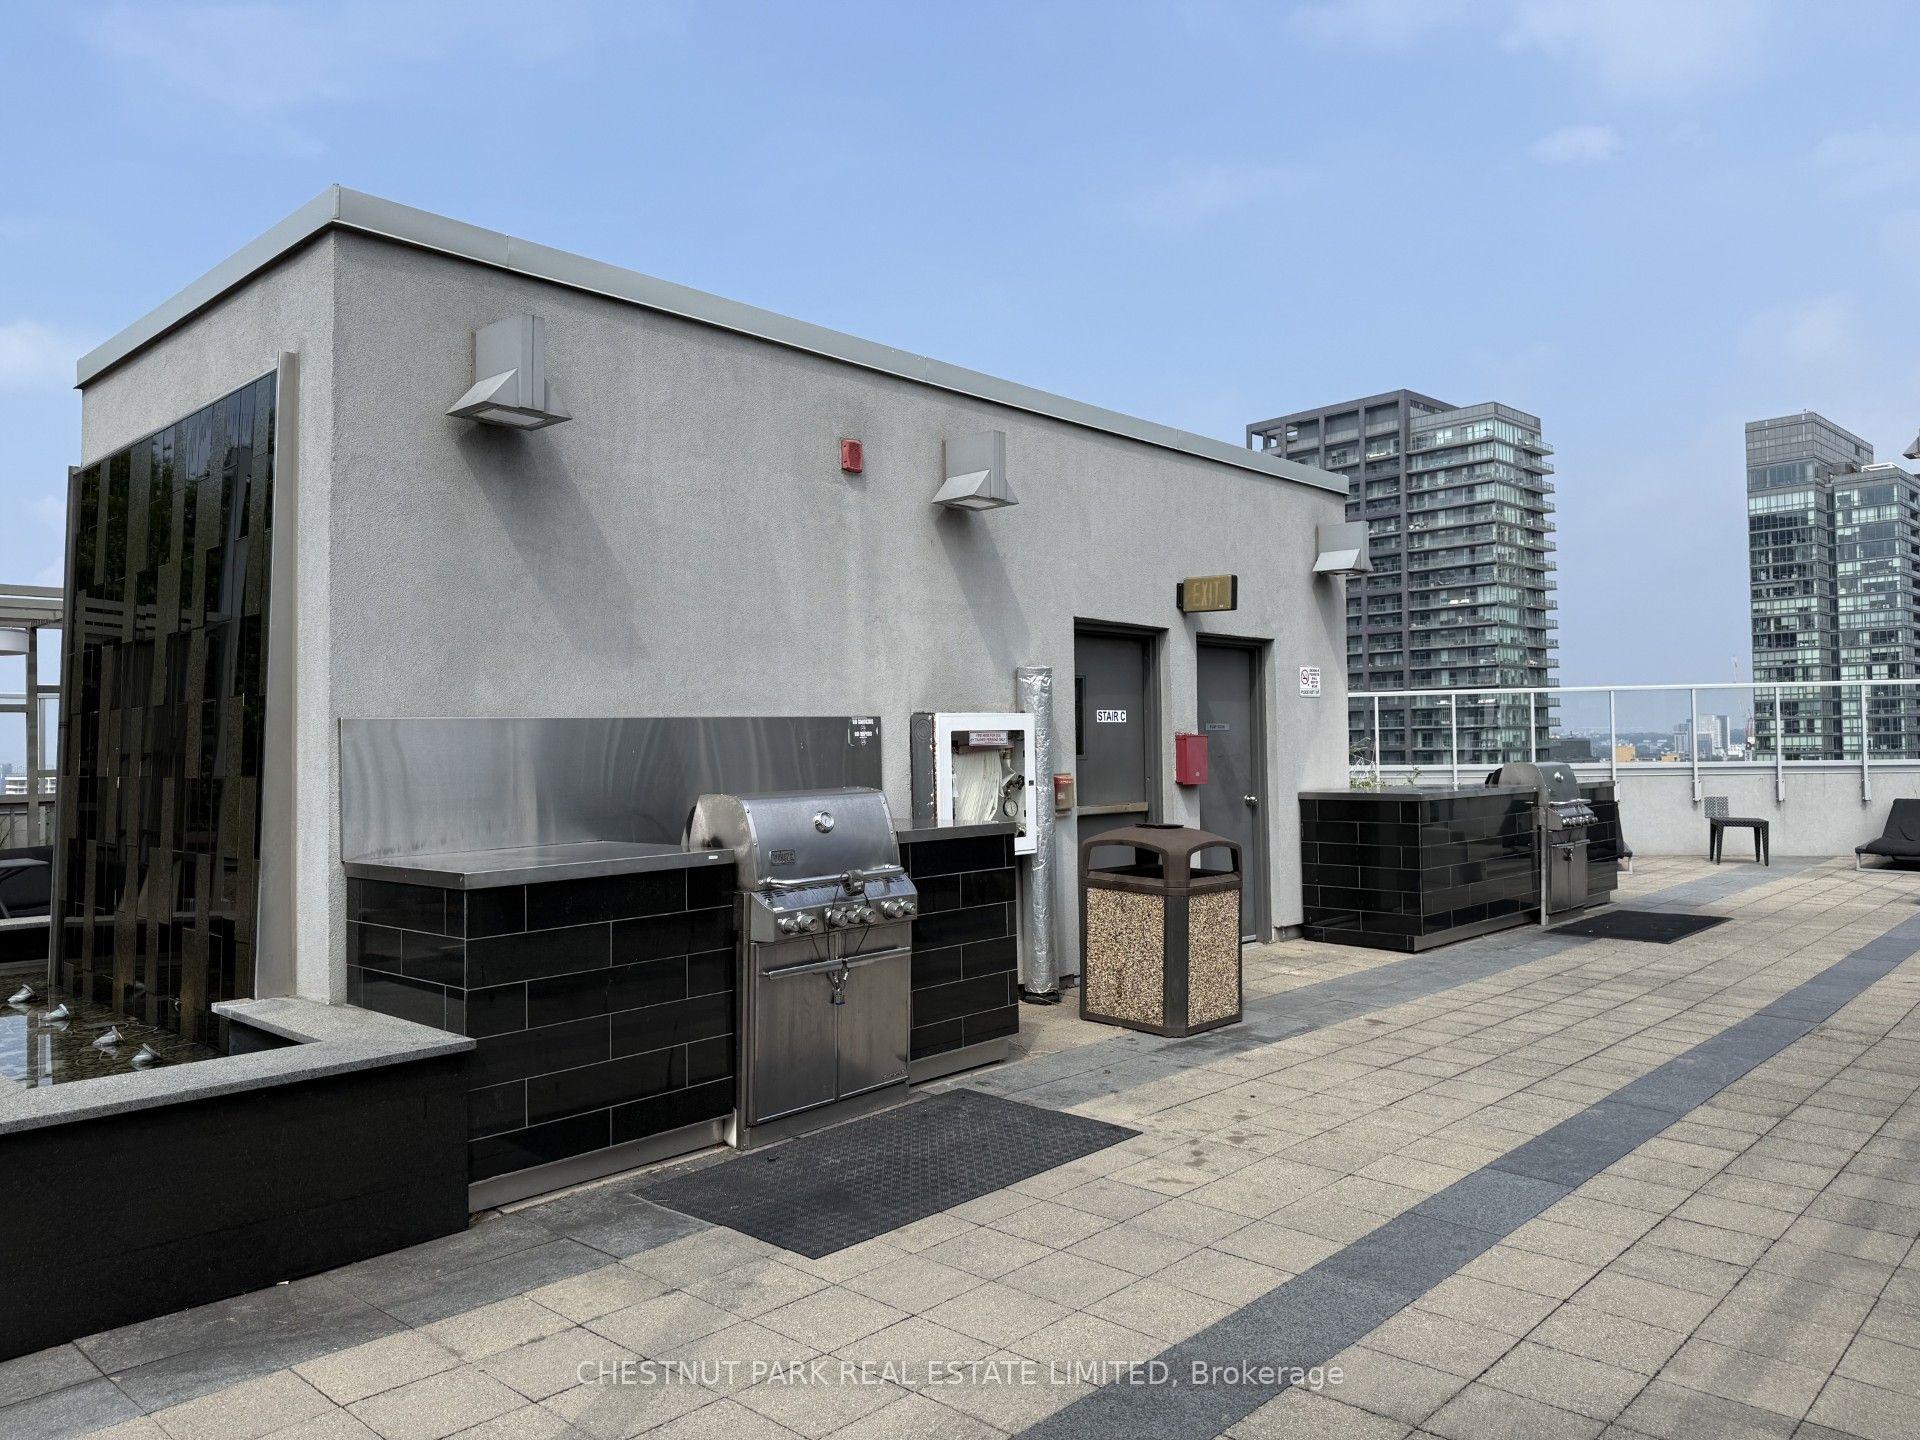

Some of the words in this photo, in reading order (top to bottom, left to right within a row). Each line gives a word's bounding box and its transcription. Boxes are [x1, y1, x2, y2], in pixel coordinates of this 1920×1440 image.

[1192, 581, 1220, 607] EXIT
[1097, 711, 1119, 721] STAIR
[1120, 711, 1126, 721] C
